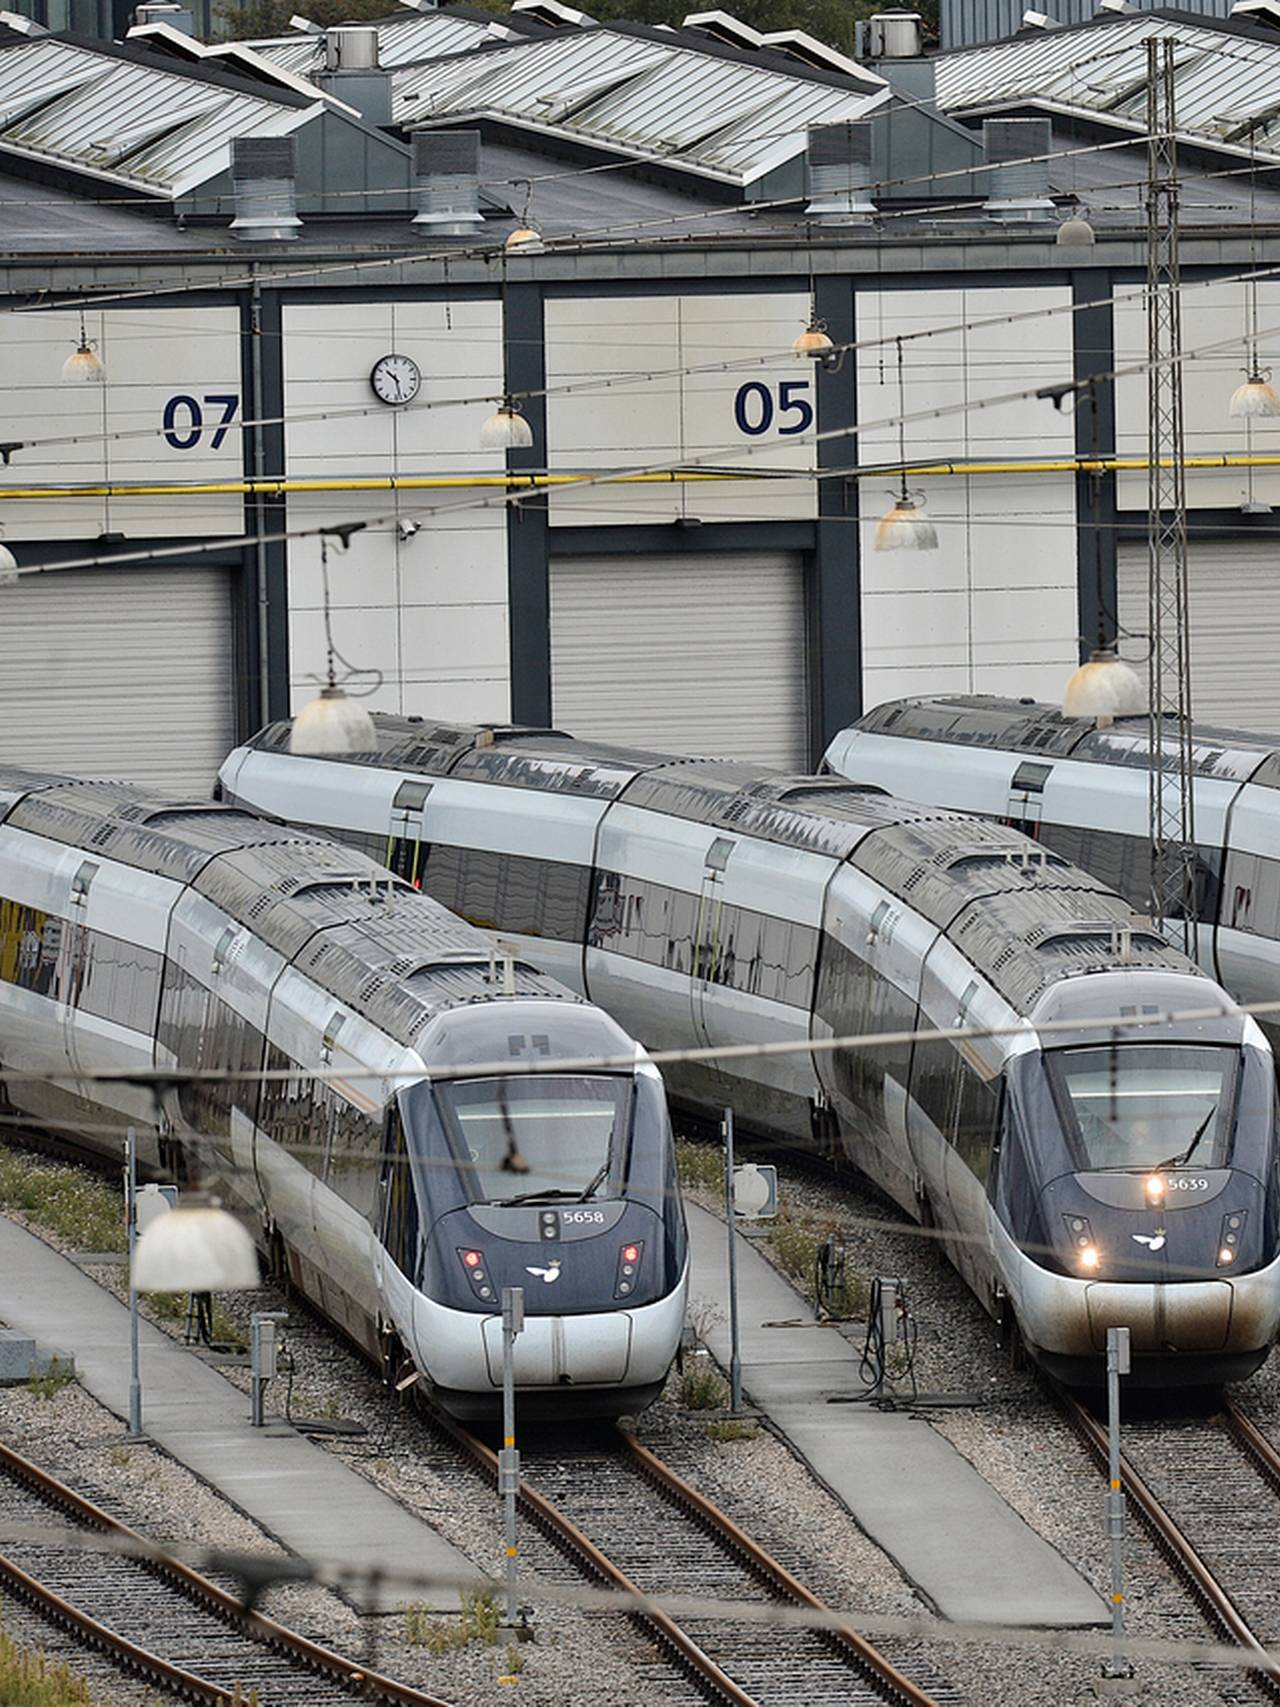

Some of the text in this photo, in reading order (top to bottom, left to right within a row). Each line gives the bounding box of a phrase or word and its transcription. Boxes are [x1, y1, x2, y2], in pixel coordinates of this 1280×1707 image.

[164, 395, 238, 449] 07
[735, 382, 813, 435] 05
[1168, 1178, 1209, 1191] 5639
[563, 1211, 604, 1225] 5658
